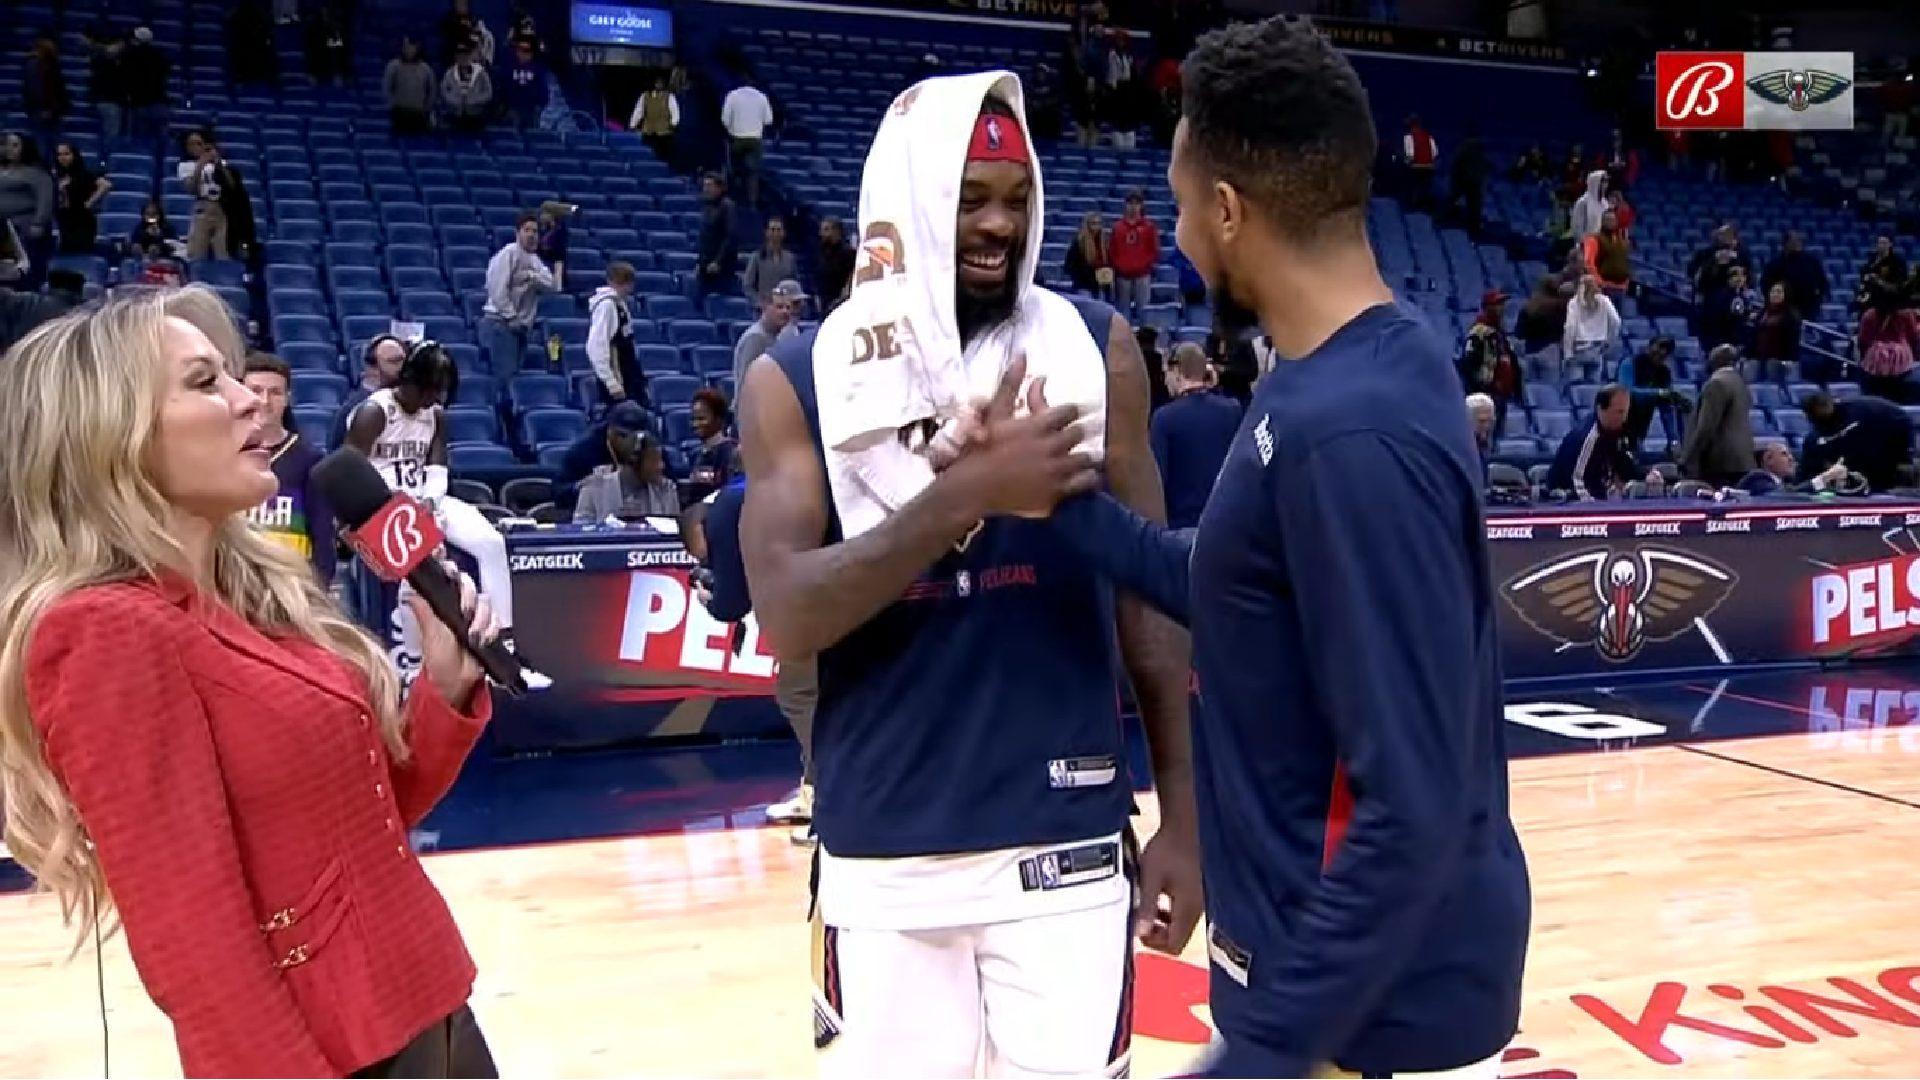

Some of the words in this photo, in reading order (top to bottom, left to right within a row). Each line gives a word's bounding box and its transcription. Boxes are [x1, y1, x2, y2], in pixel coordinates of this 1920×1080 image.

[977, 0, 1077, 16] BETRIVE
[1634, 522, 1681, 536] SEATGEEK
[1705, 519, 1750, 533] SEATGEEK
[1775, 516, 1819, 530] SEATGEEK
[382, 503, 423, 568] B
[1561, 524, 1608, 539] SEATGEEK
[510, 552, 584, 570] SEATGEEK
[618, 570, 780, 678] PEL
